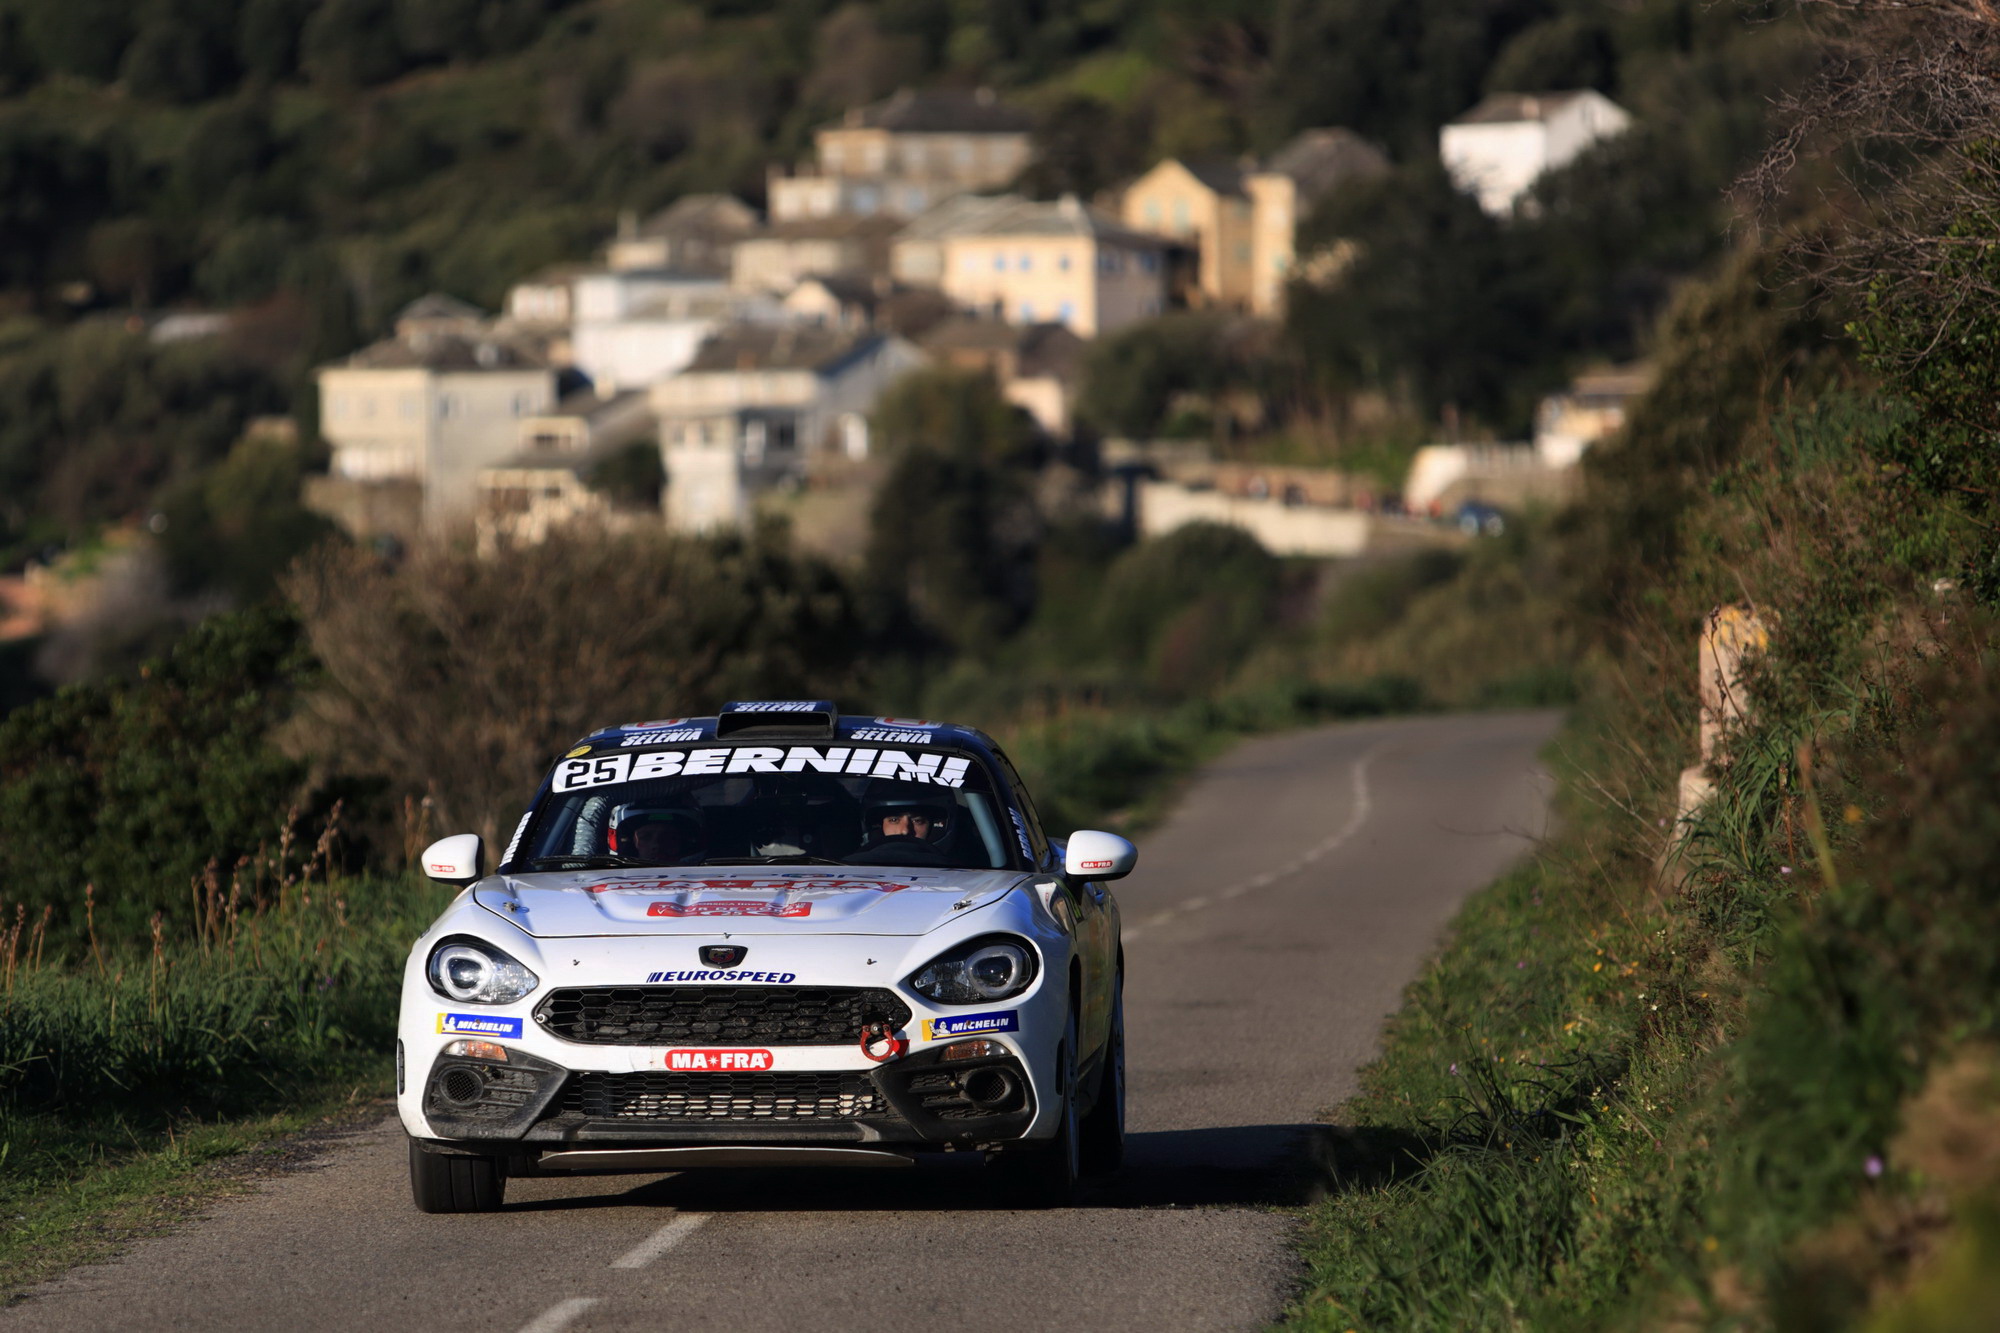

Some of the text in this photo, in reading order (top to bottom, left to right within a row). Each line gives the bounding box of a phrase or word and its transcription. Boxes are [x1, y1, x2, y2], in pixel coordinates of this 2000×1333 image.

[734, 704, 816, 712] SELENIA
[620, 730, 703, 747] SELENIA
[851, 730, 932, 744] SELENIA
[565, 757, 618, 789] 25
[628, 747, 971, 781] BERNINI
[662, 970, 796, 984] EUROSPEED
[456, 1020, 514, 1032] MICHELIN
[951, 1018, 1009, 1032] MICHELIN
